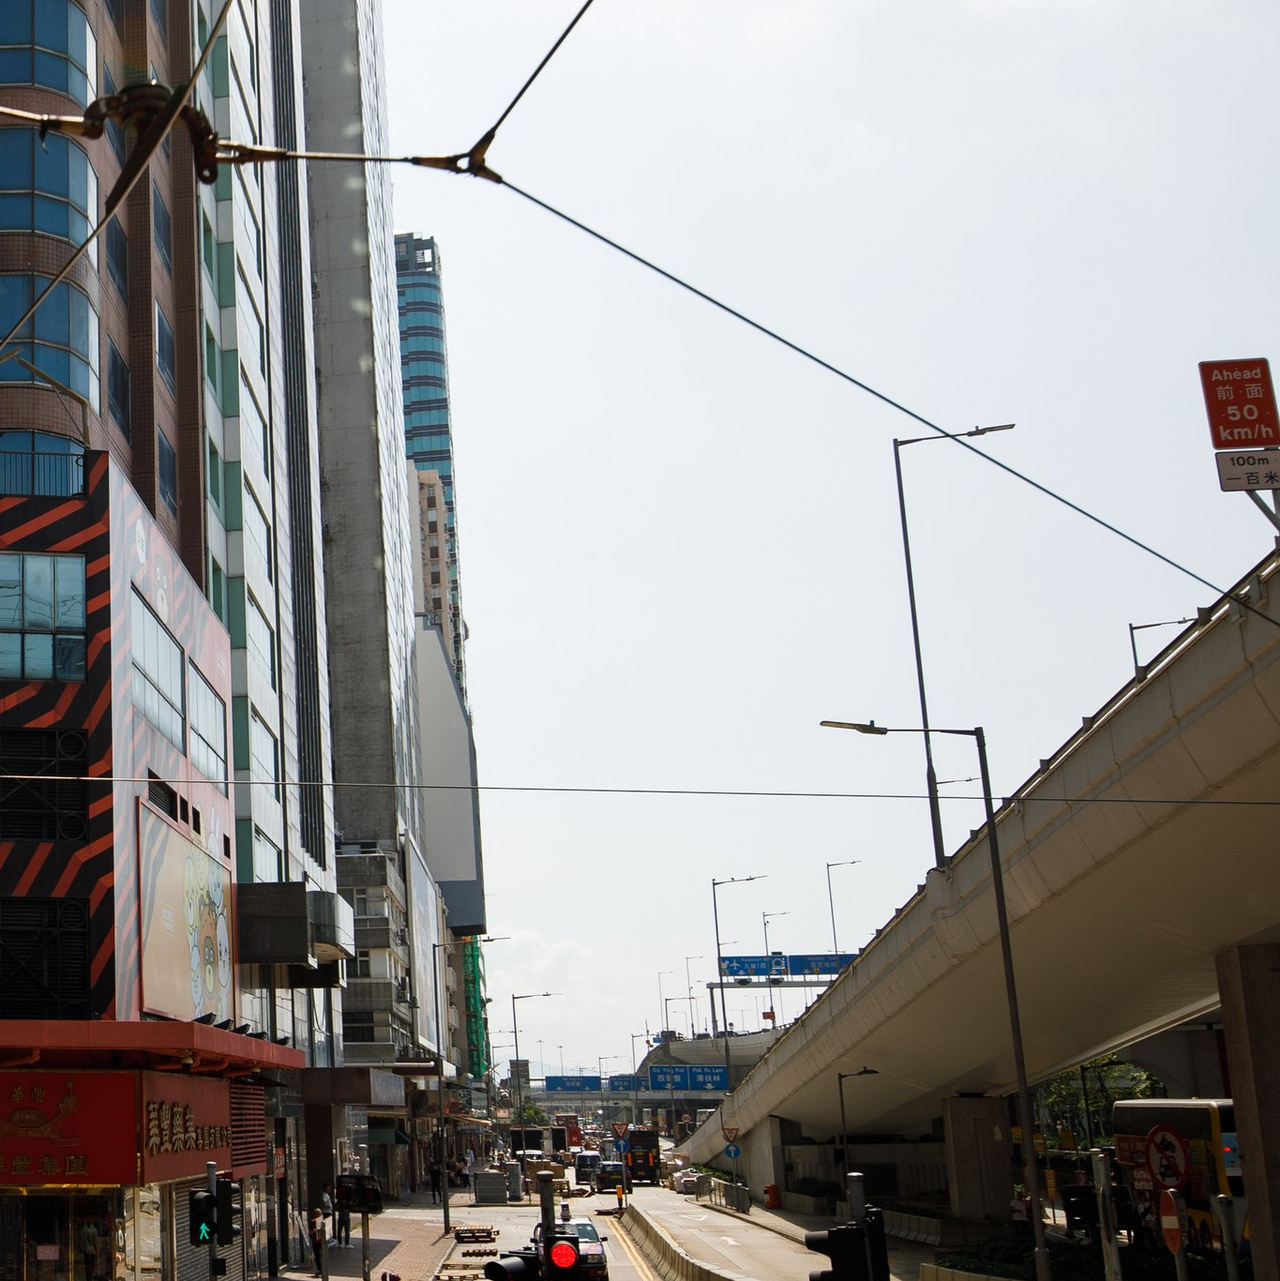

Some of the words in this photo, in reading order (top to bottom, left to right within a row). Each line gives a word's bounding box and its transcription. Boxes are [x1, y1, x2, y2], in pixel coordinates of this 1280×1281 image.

[1211, 367, 1262, 381] Ahead
[1216, 383, 1264, 400] 前面
[1227, 405, 1259, 421] 50
[1219, 424, 1274, 441] km/h
[1230, 456, 1270, 467] 100m
[1226, 471, 1280, 486] 一百米
[10, 1085, 47, 1103] 華豐
